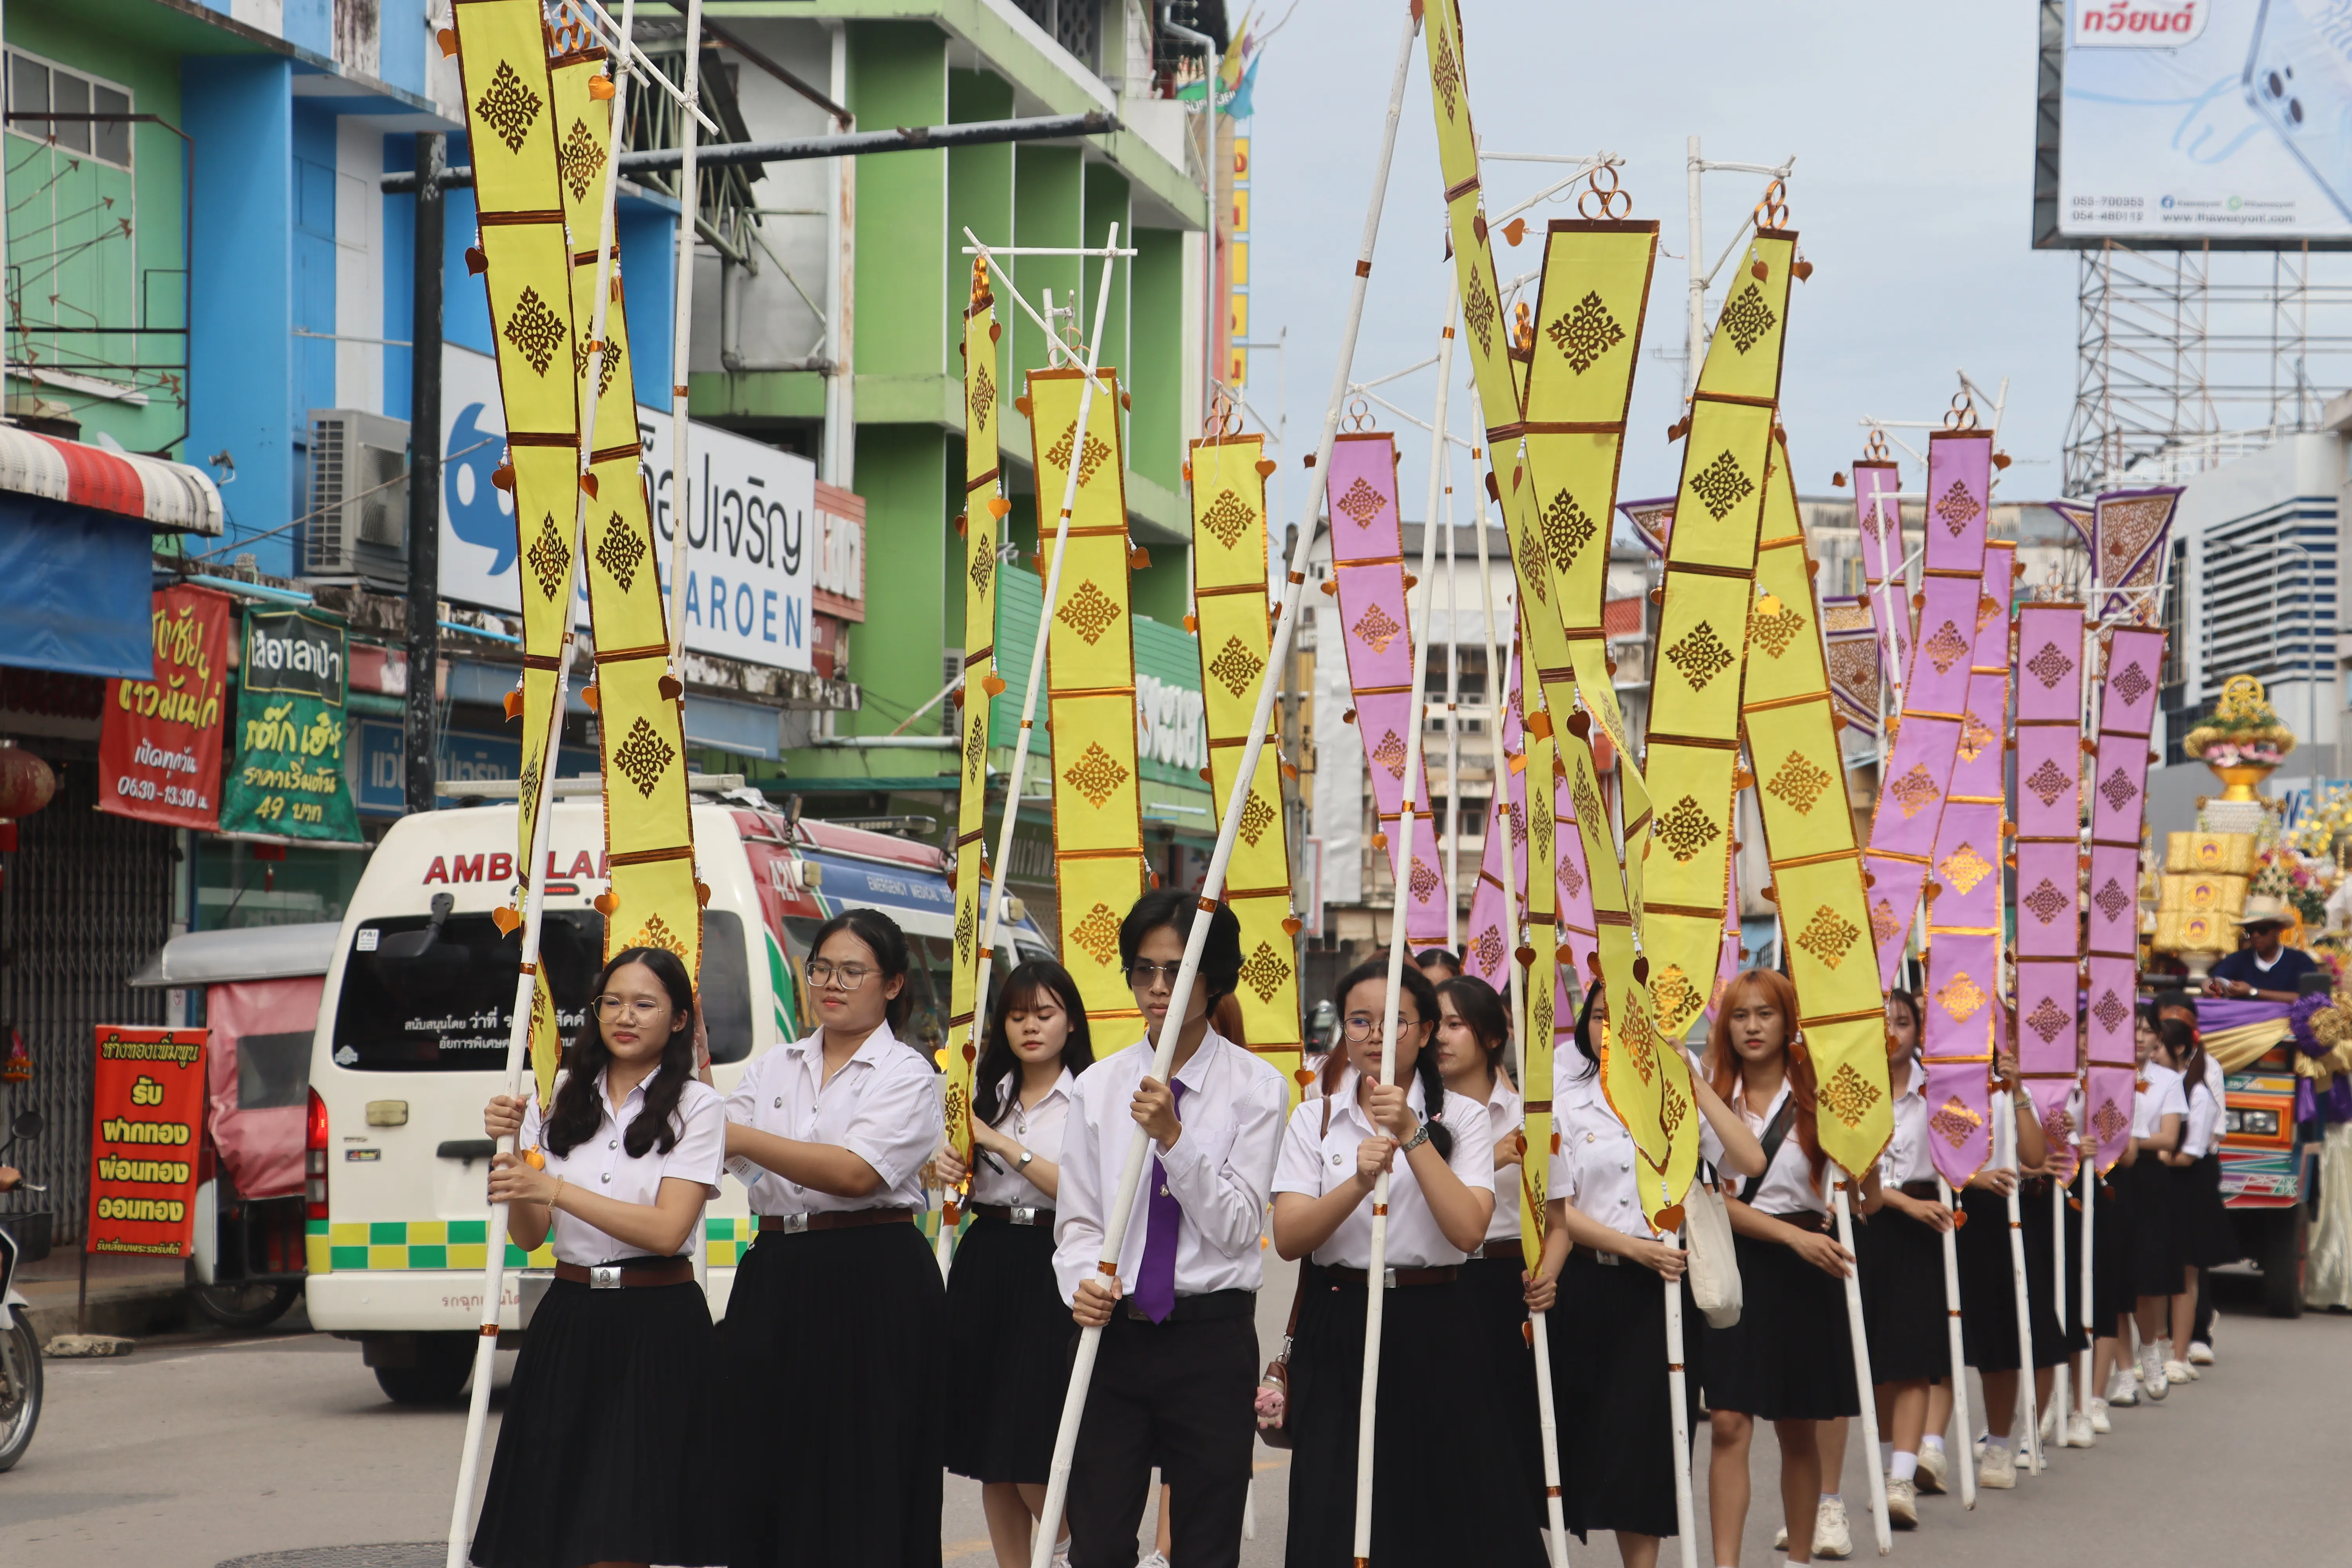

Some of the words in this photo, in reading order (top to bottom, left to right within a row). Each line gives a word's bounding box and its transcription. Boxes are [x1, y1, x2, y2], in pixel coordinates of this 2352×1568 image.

[134, 737, 197, 779] เปิดทุกวัน
[243, 757, 336, 794] ราคาเริ่มต้น
[254, 795, 285, 820] 49
[292, 802, 322, 823] บาท
[866, 875, 908, 897] EMERGENCY
[909, 884, 940, 902] MEDICAL
[102, 1034, 199, 1068] ห้างทองเพิ่มพูน
[132, 1076, 162, 1105] รับ
[102, 1117, 190, 1145] ฝากทอง
[98, 1155, 190, 1183] ผ่อนทอง
[98, 1198, 185, 1222] ออมทอง
